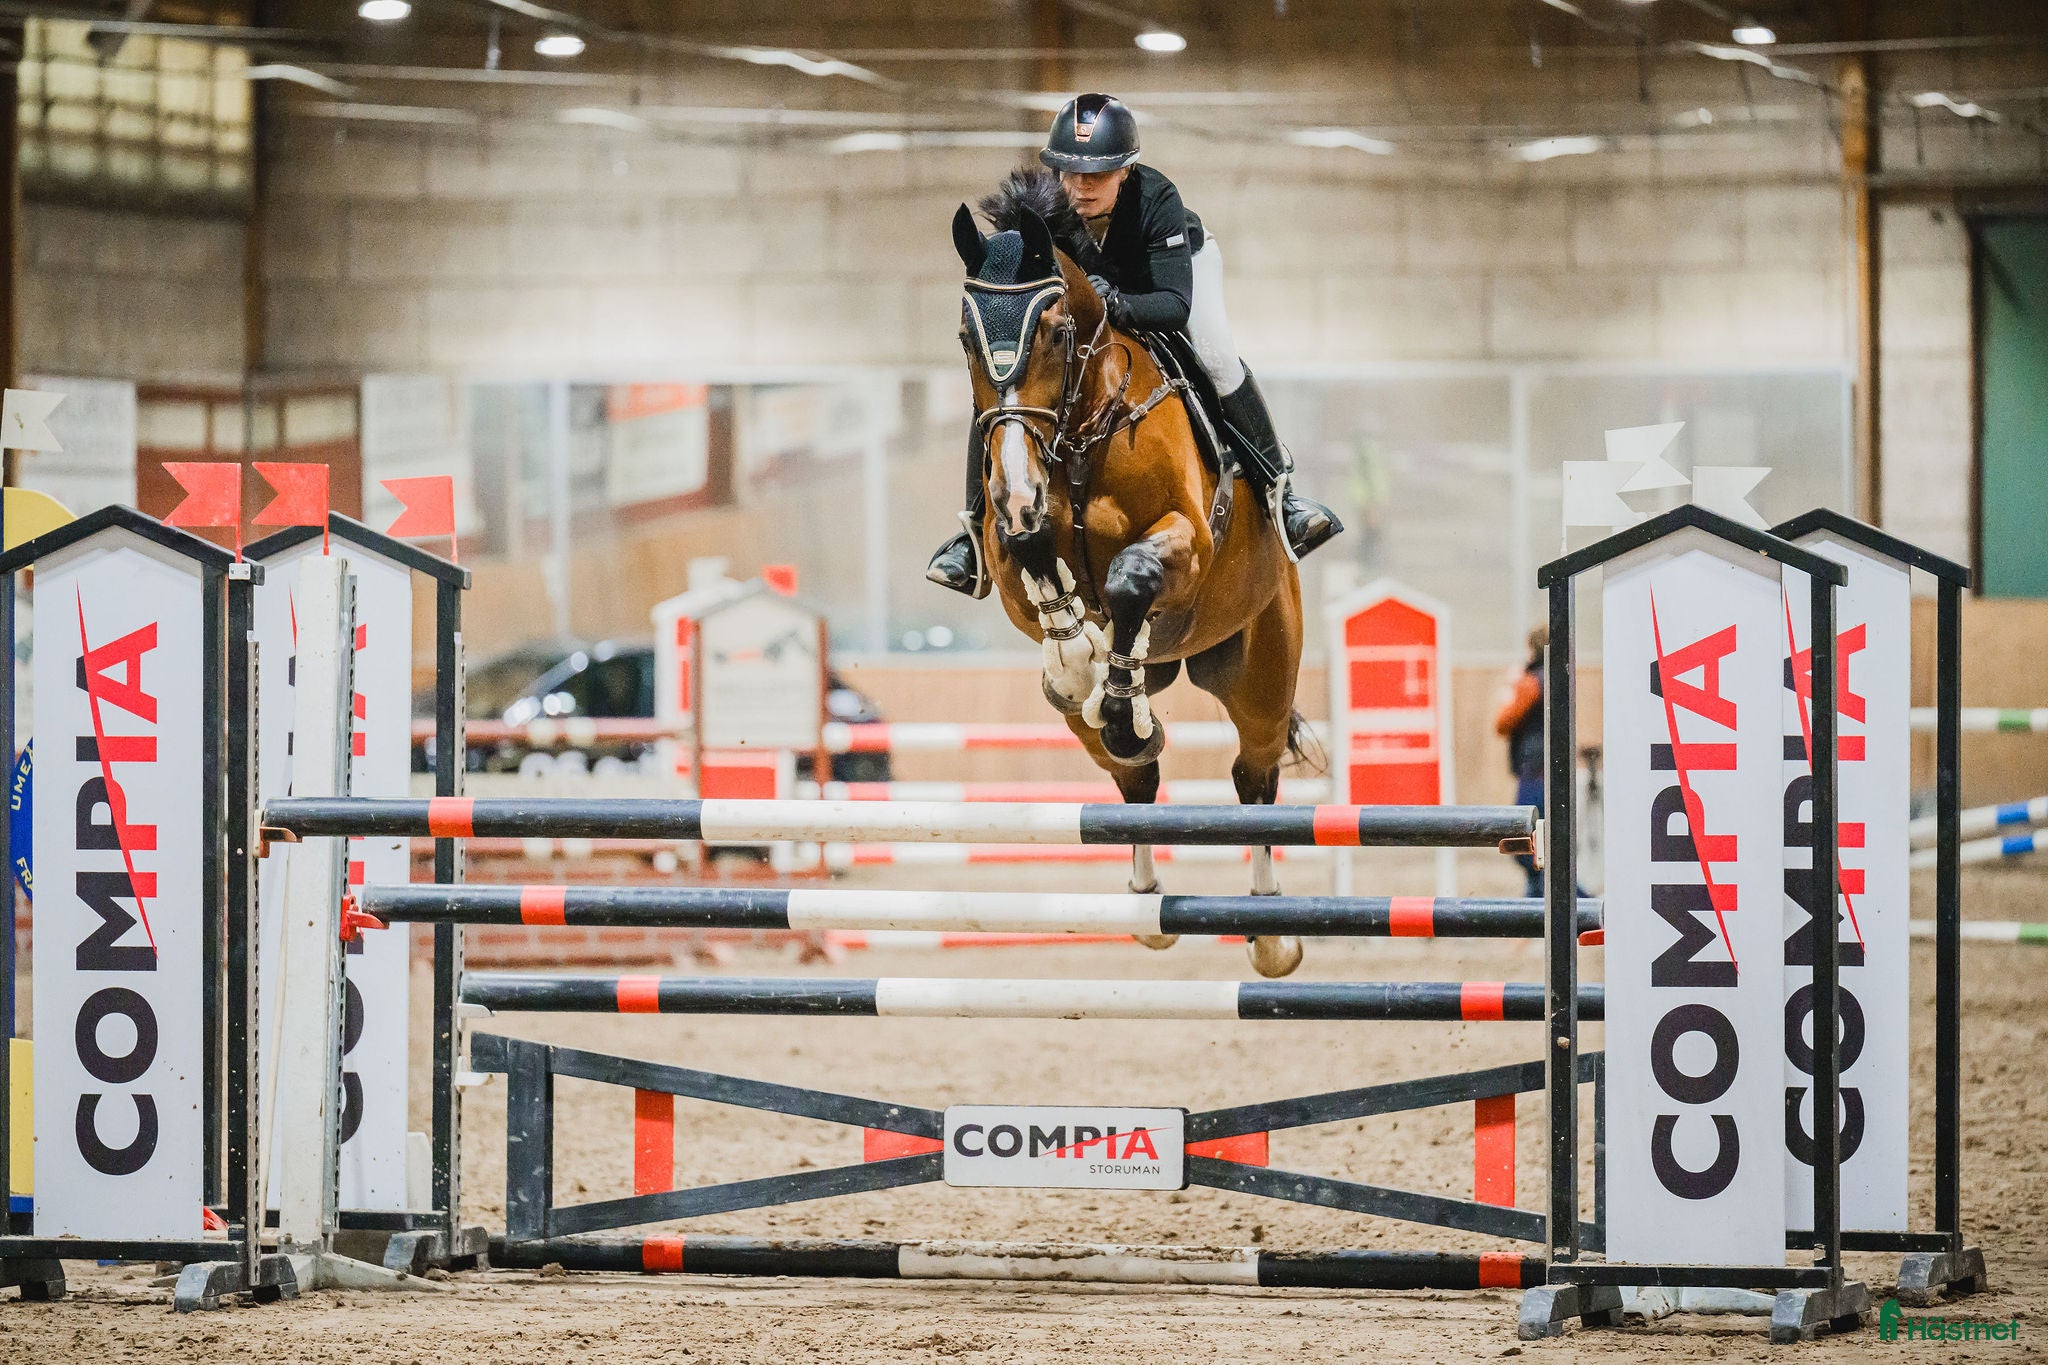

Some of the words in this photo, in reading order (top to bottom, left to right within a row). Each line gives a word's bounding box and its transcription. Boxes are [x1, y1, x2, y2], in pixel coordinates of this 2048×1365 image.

[75, 621, 159, 1176] COMPIA
[1650, 623, 1741, 1200] COMPIA
[953, 1124, 1160, 1160] COMPIA
[1089, 1164, 1161, 1175] STORUMAN
